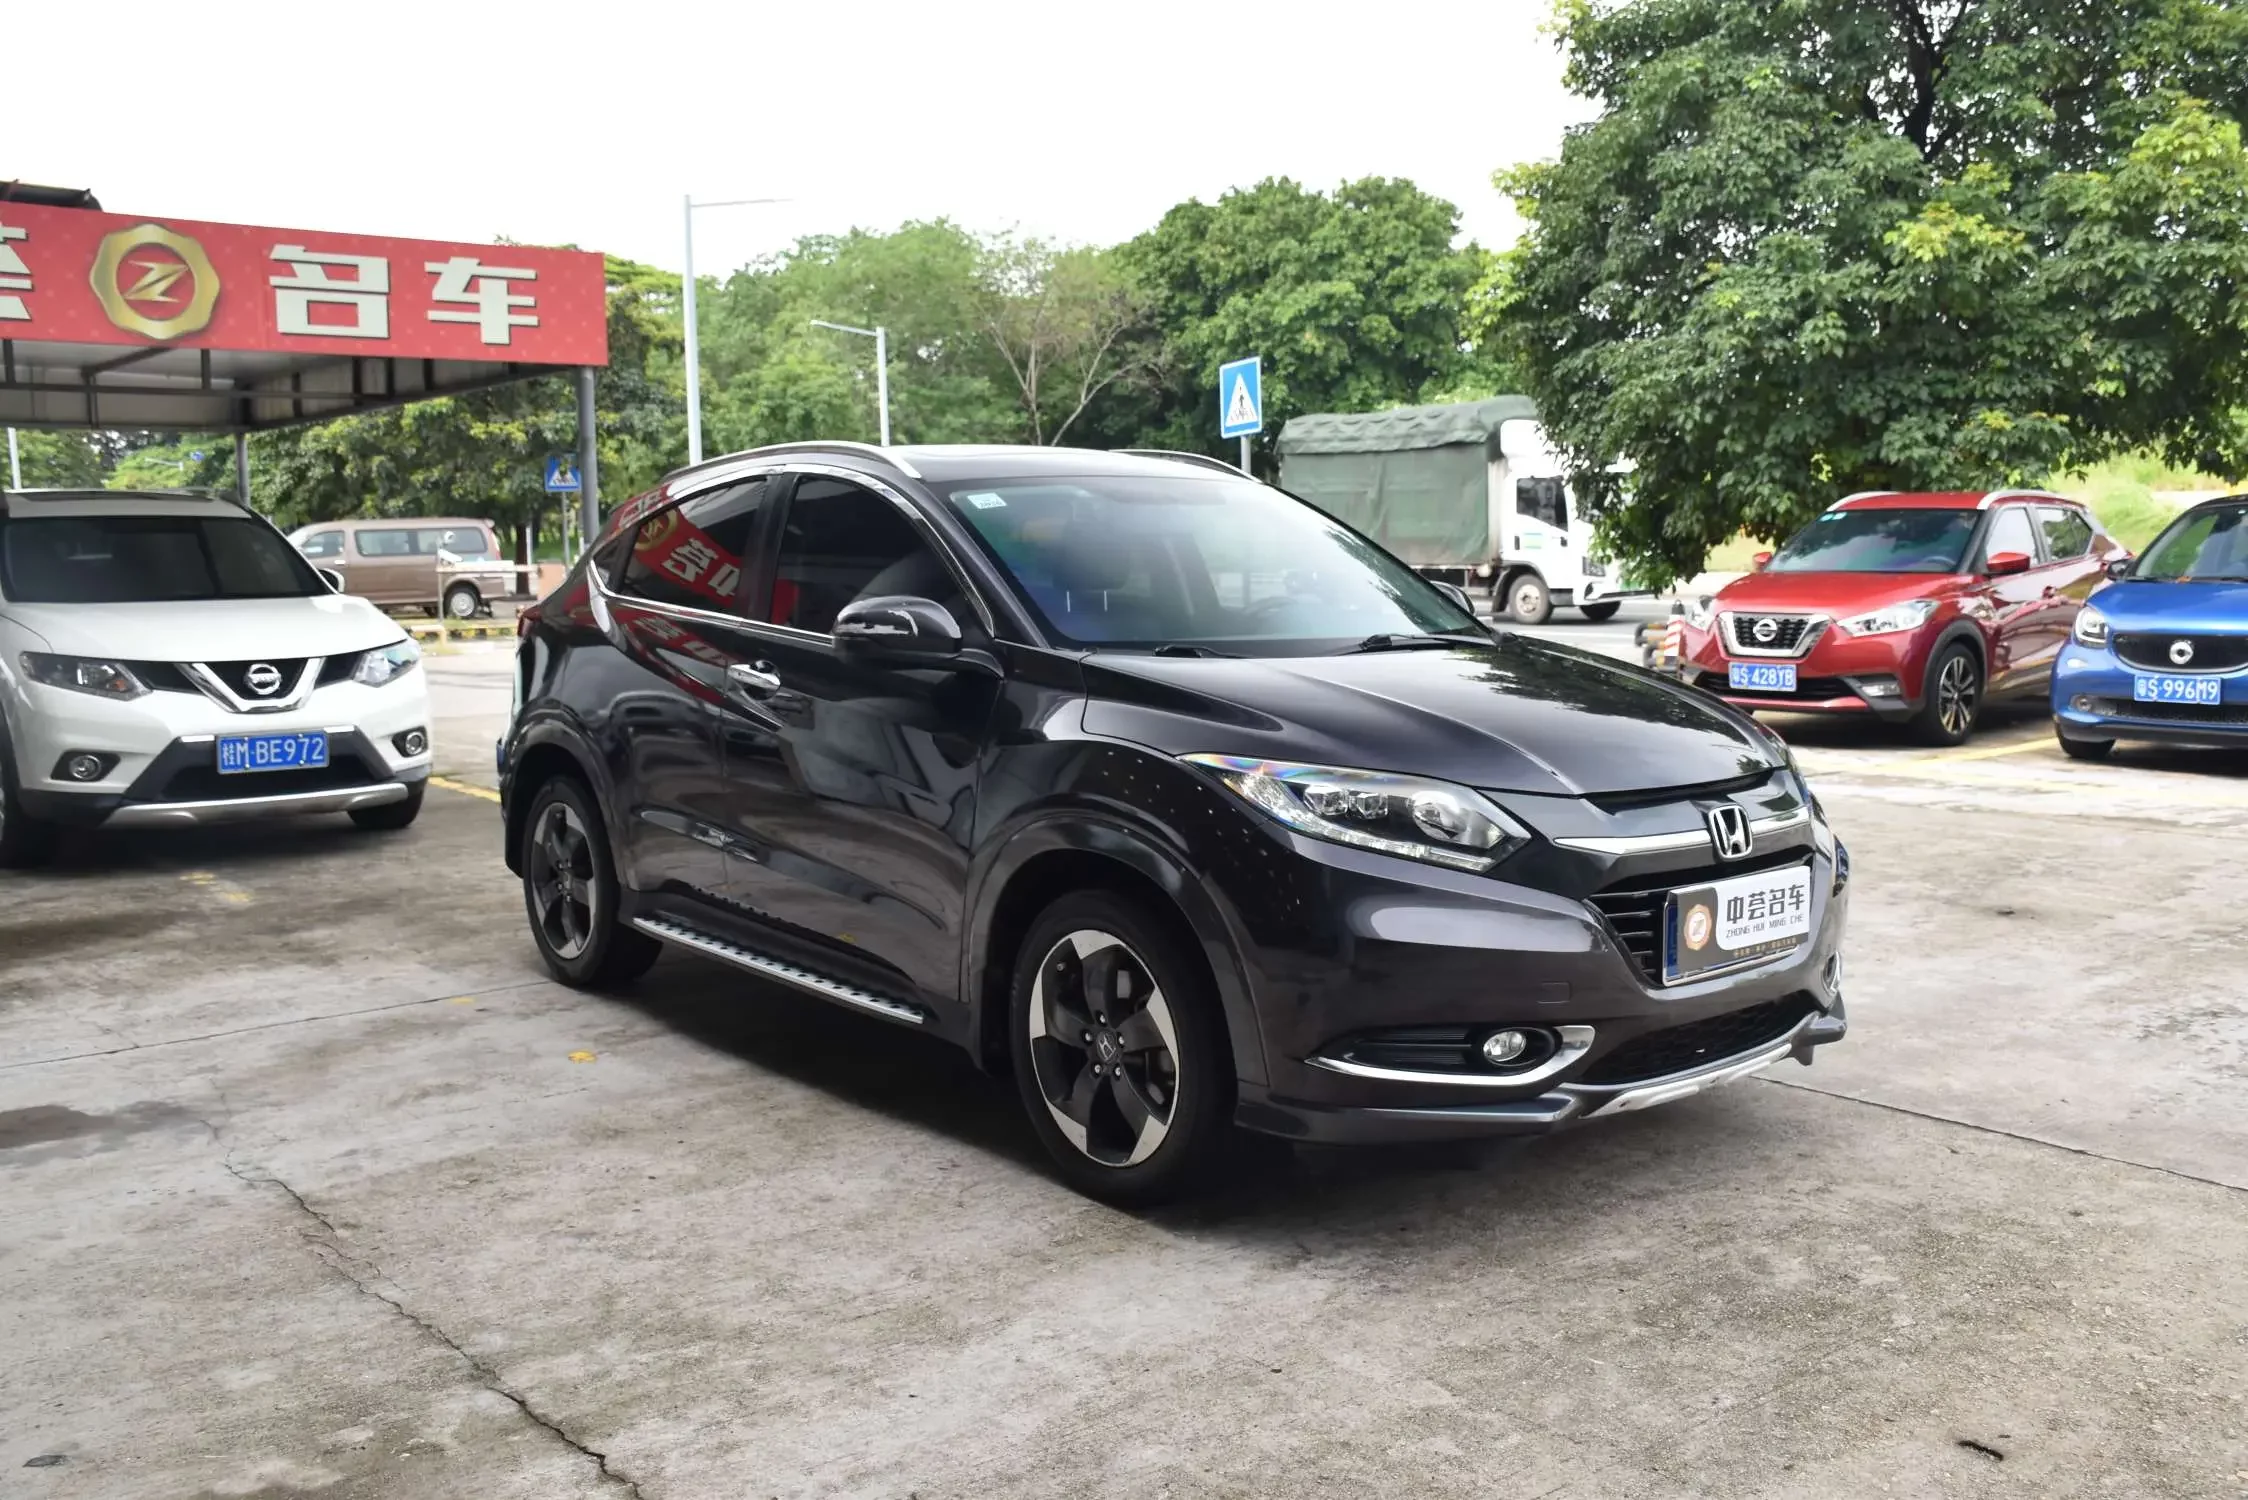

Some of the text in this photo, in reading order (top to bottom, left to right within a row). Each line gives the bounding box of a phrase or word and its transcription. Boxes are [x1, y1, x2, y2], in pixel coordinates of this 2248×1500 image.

[269, 244, 539, 345] 名车
[1726, 884, 1805, 924] 中荟名车
[1726, 925, 1751, 938] ZHONG
[1753, 923, 1765, 933] HUI
[1768, 917, 1786, 928] MING
